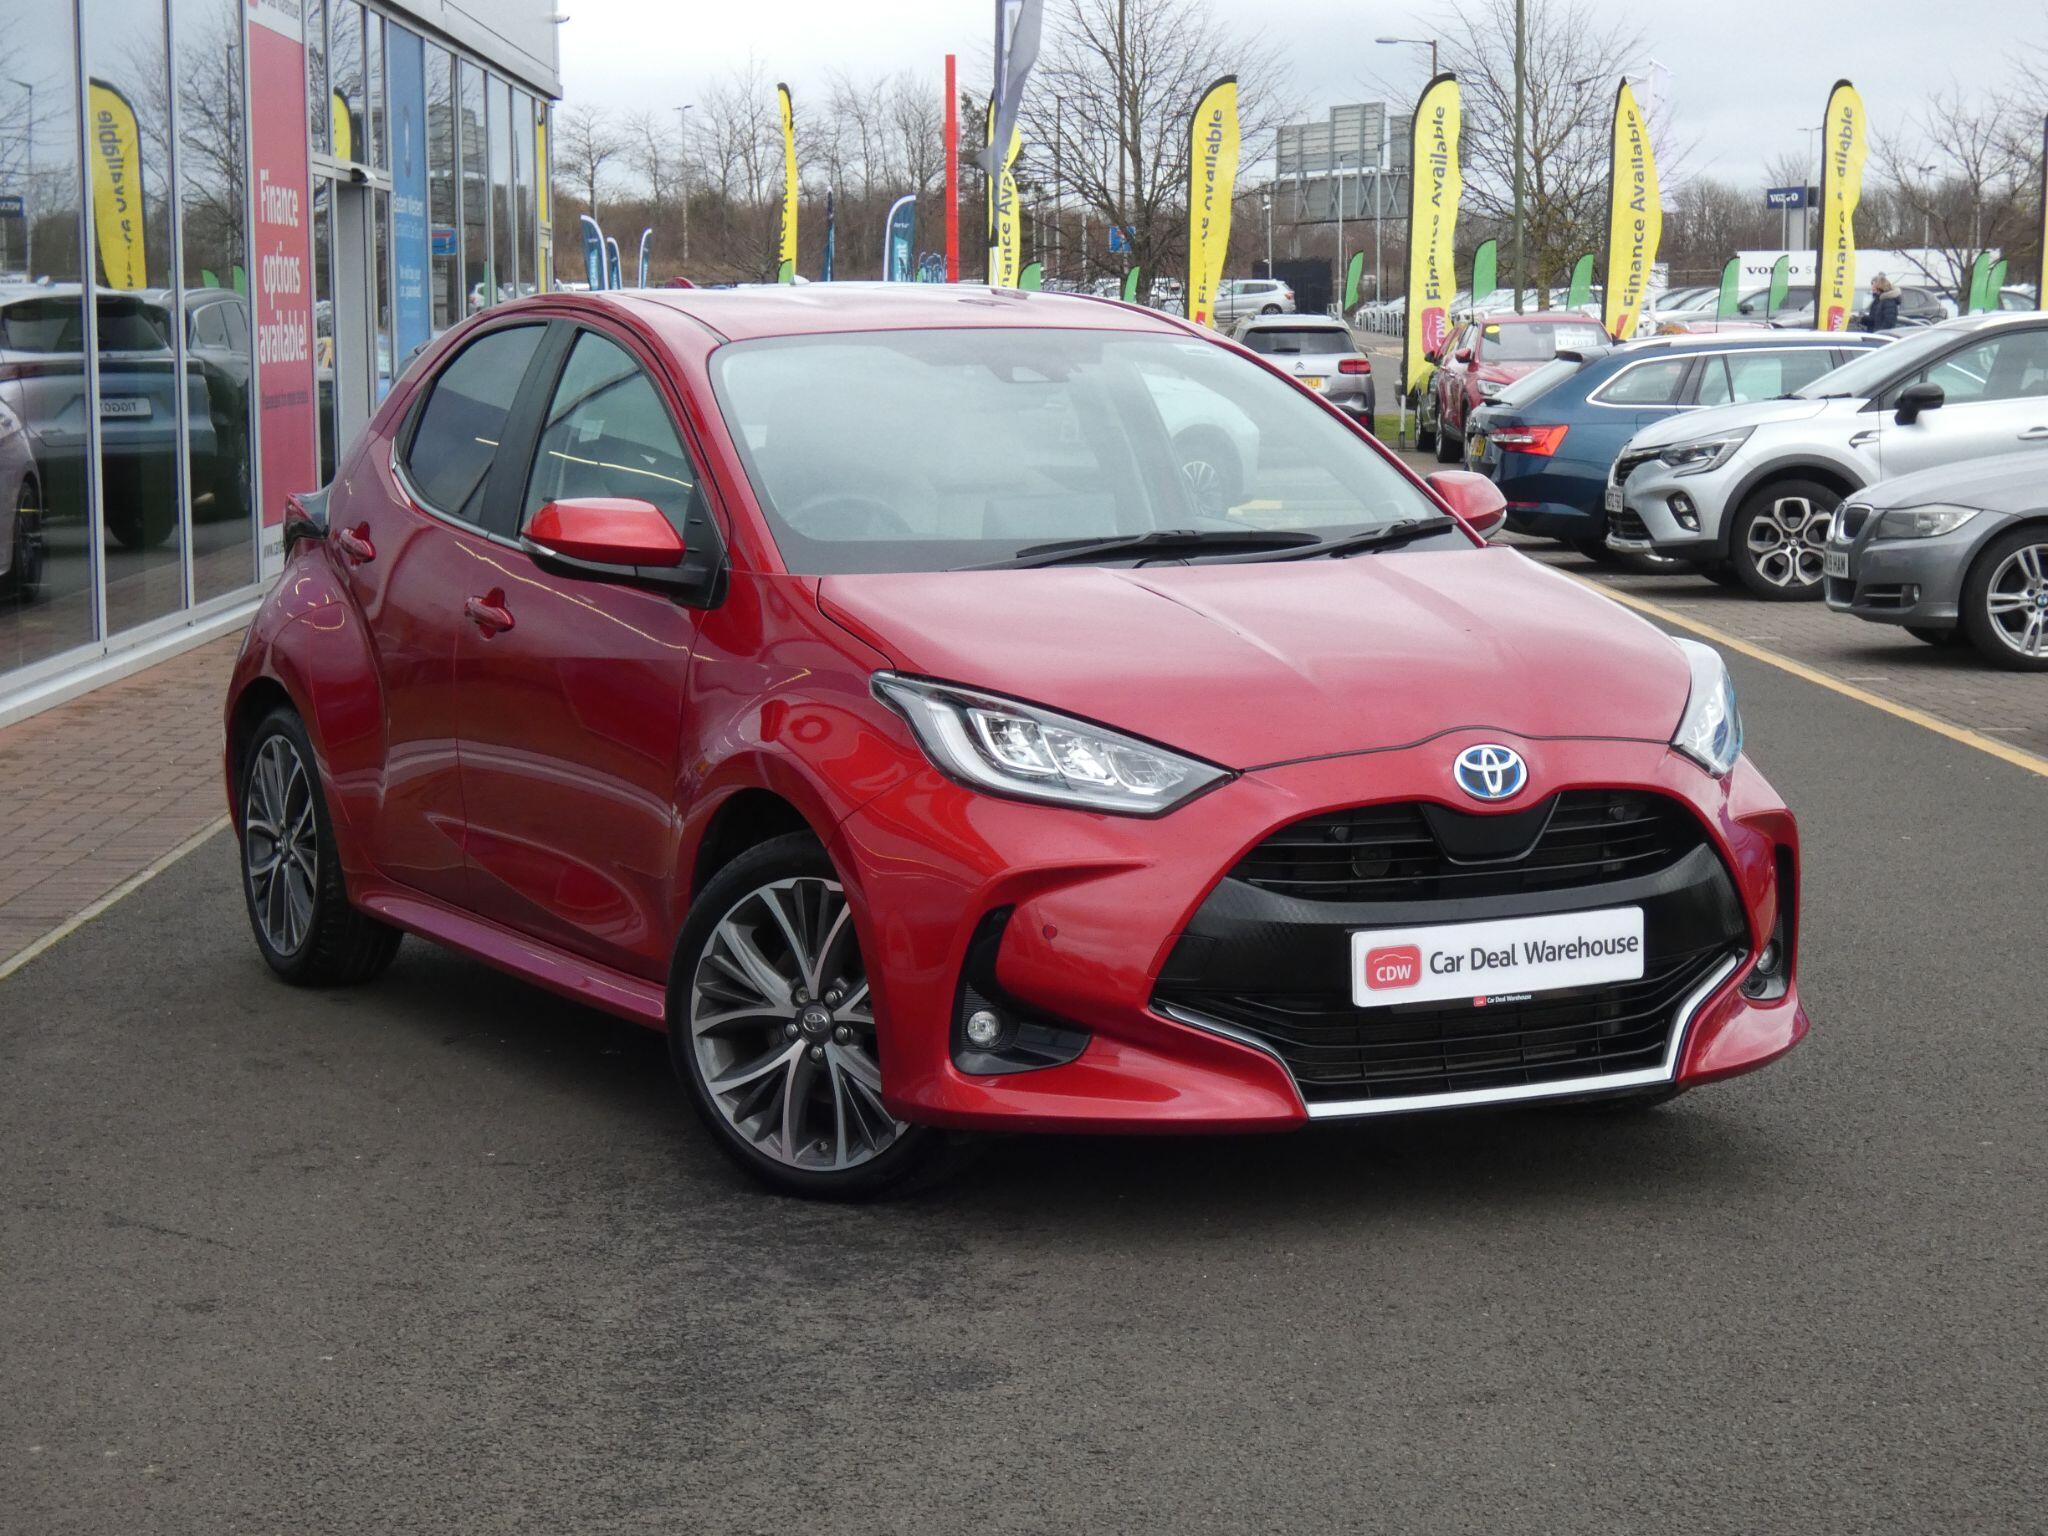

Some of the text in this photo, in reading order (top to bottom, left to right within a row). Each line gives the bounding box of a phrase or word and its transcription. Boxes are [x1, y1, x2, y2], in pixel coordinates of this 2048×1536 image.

[1430, 106, 1448, 207] Available
[1627, 110, 1645, 211] Available
[260, 168, 299, 228] Finance
[263, 241, 301, 310] options
[1001, 222, 1012, 287] nance
[1745, 266, 1799, 274] VOO
[260, 310, 307, 364] available!
[1376, 965, 1412, 982] CDW
[1430, 936, 1639, 975] Car Deal Warehouse
